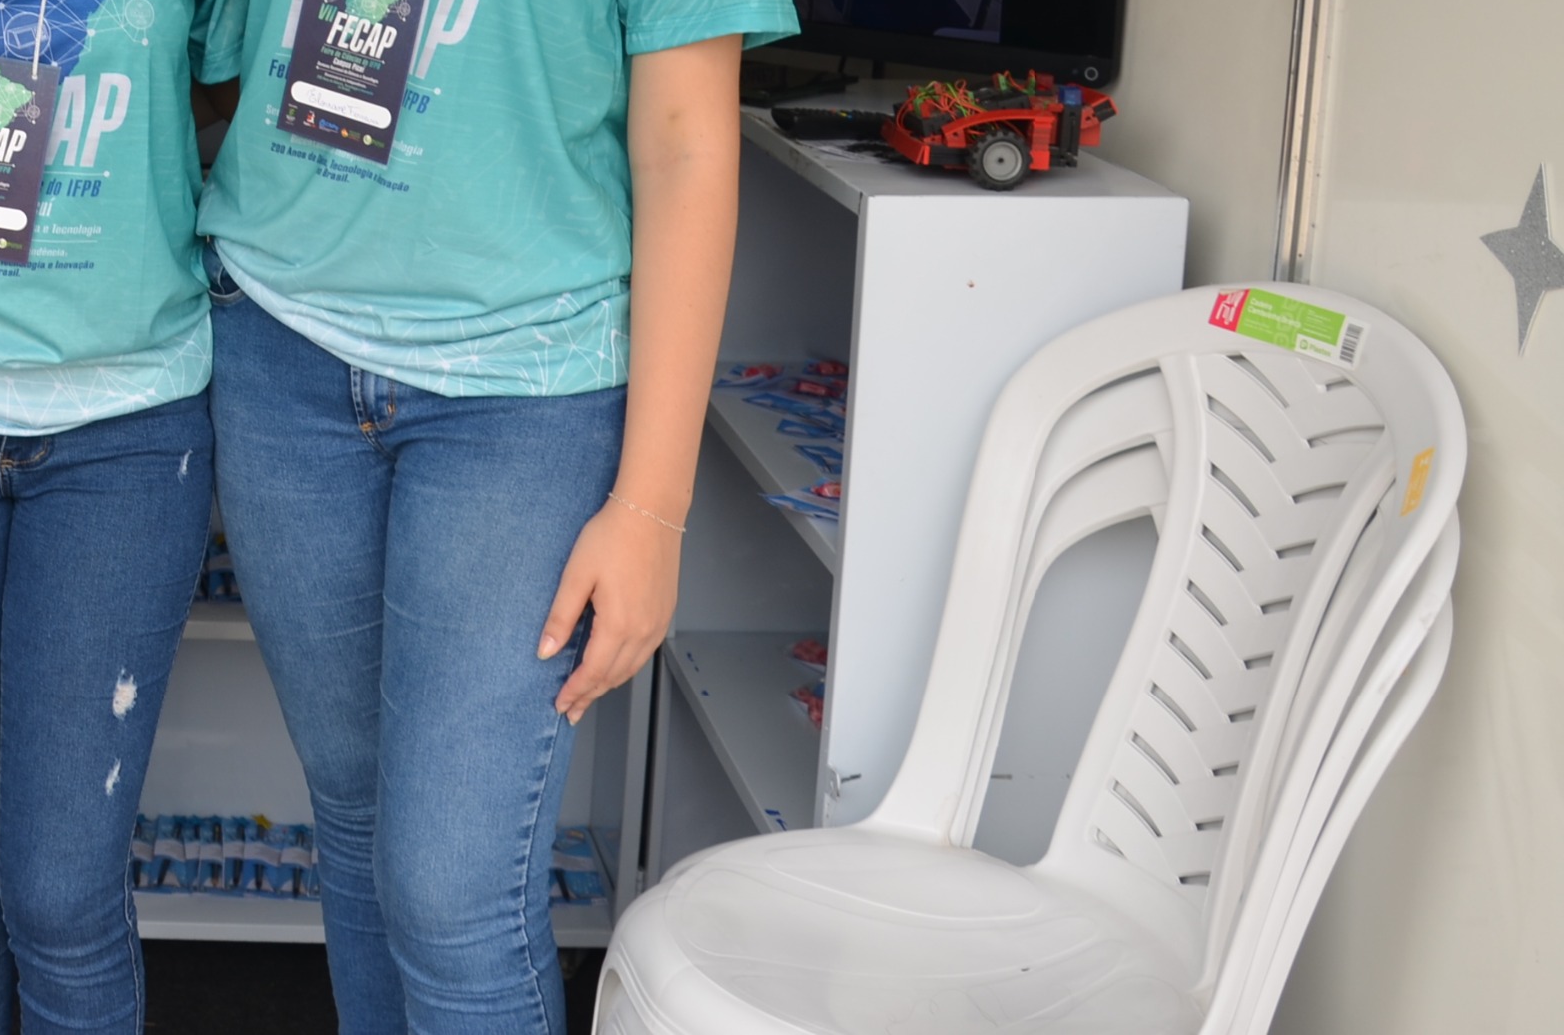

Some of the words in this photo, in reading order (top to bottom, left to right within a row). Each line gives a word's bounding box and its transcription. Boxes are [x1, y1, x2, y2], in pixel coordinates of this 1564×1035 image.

[318, 3, 338, 23] VII
[326, 11, 397, 59] FECAP
[46, 179, 61, 195] do
[67, 178, 102, 197] IFPB
[51, 223, 102, 237] Tecnologia
[55, 261, 95, 272] Inovação
